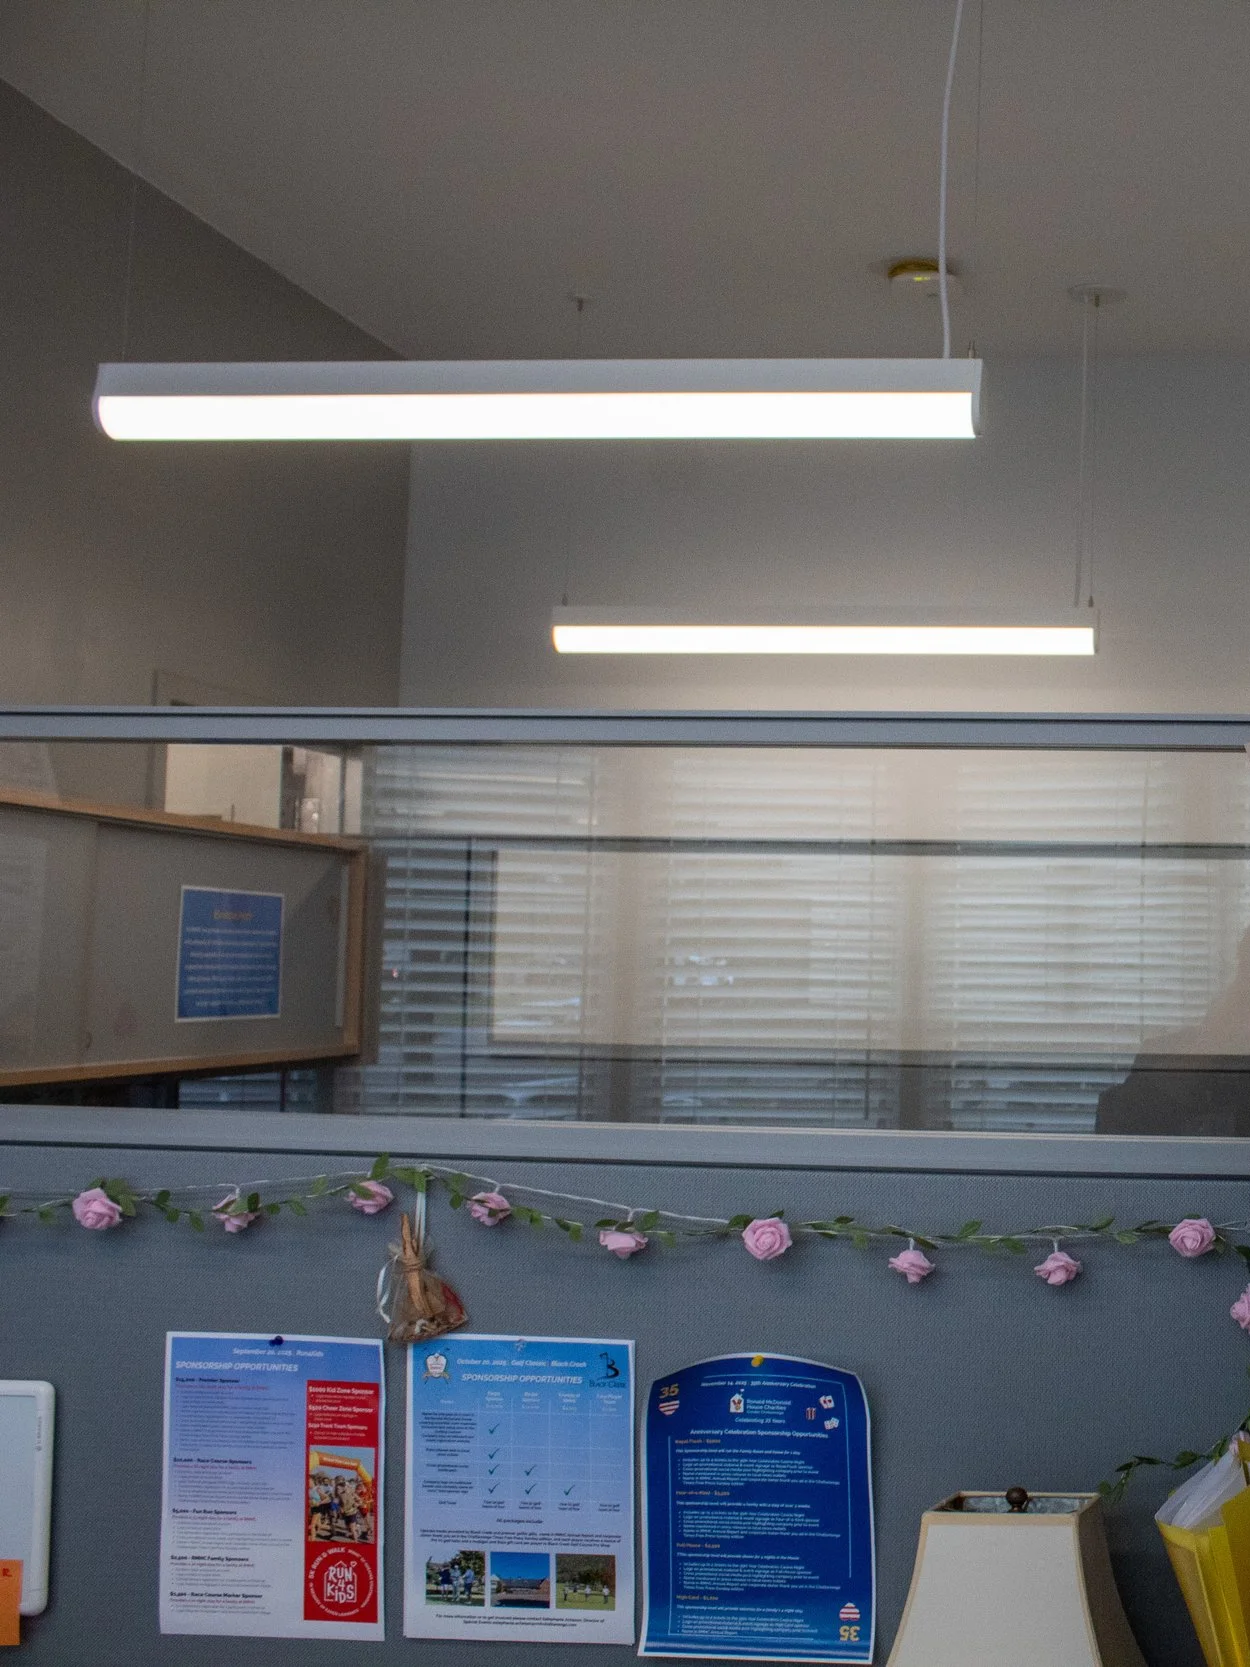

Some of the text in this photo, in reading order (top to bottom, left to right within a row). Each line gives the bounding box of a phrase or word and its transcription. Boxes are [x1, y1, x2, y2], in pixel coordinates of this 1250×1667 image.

[175, 1361, 299, 1372] SPONSORSHIP OPPORTUNITIES
[462, 1373, 583, 1384] SPONSORSHIP OPPORTUNITIES
[659, 1383, 680, 1398] 35
[690, 1428, 829, 1439] Anniversary Celebration Sponsorship Opportunities
[328, 1565, 353, 1583] RUN
[337, 1578, 346, 1592] 4
